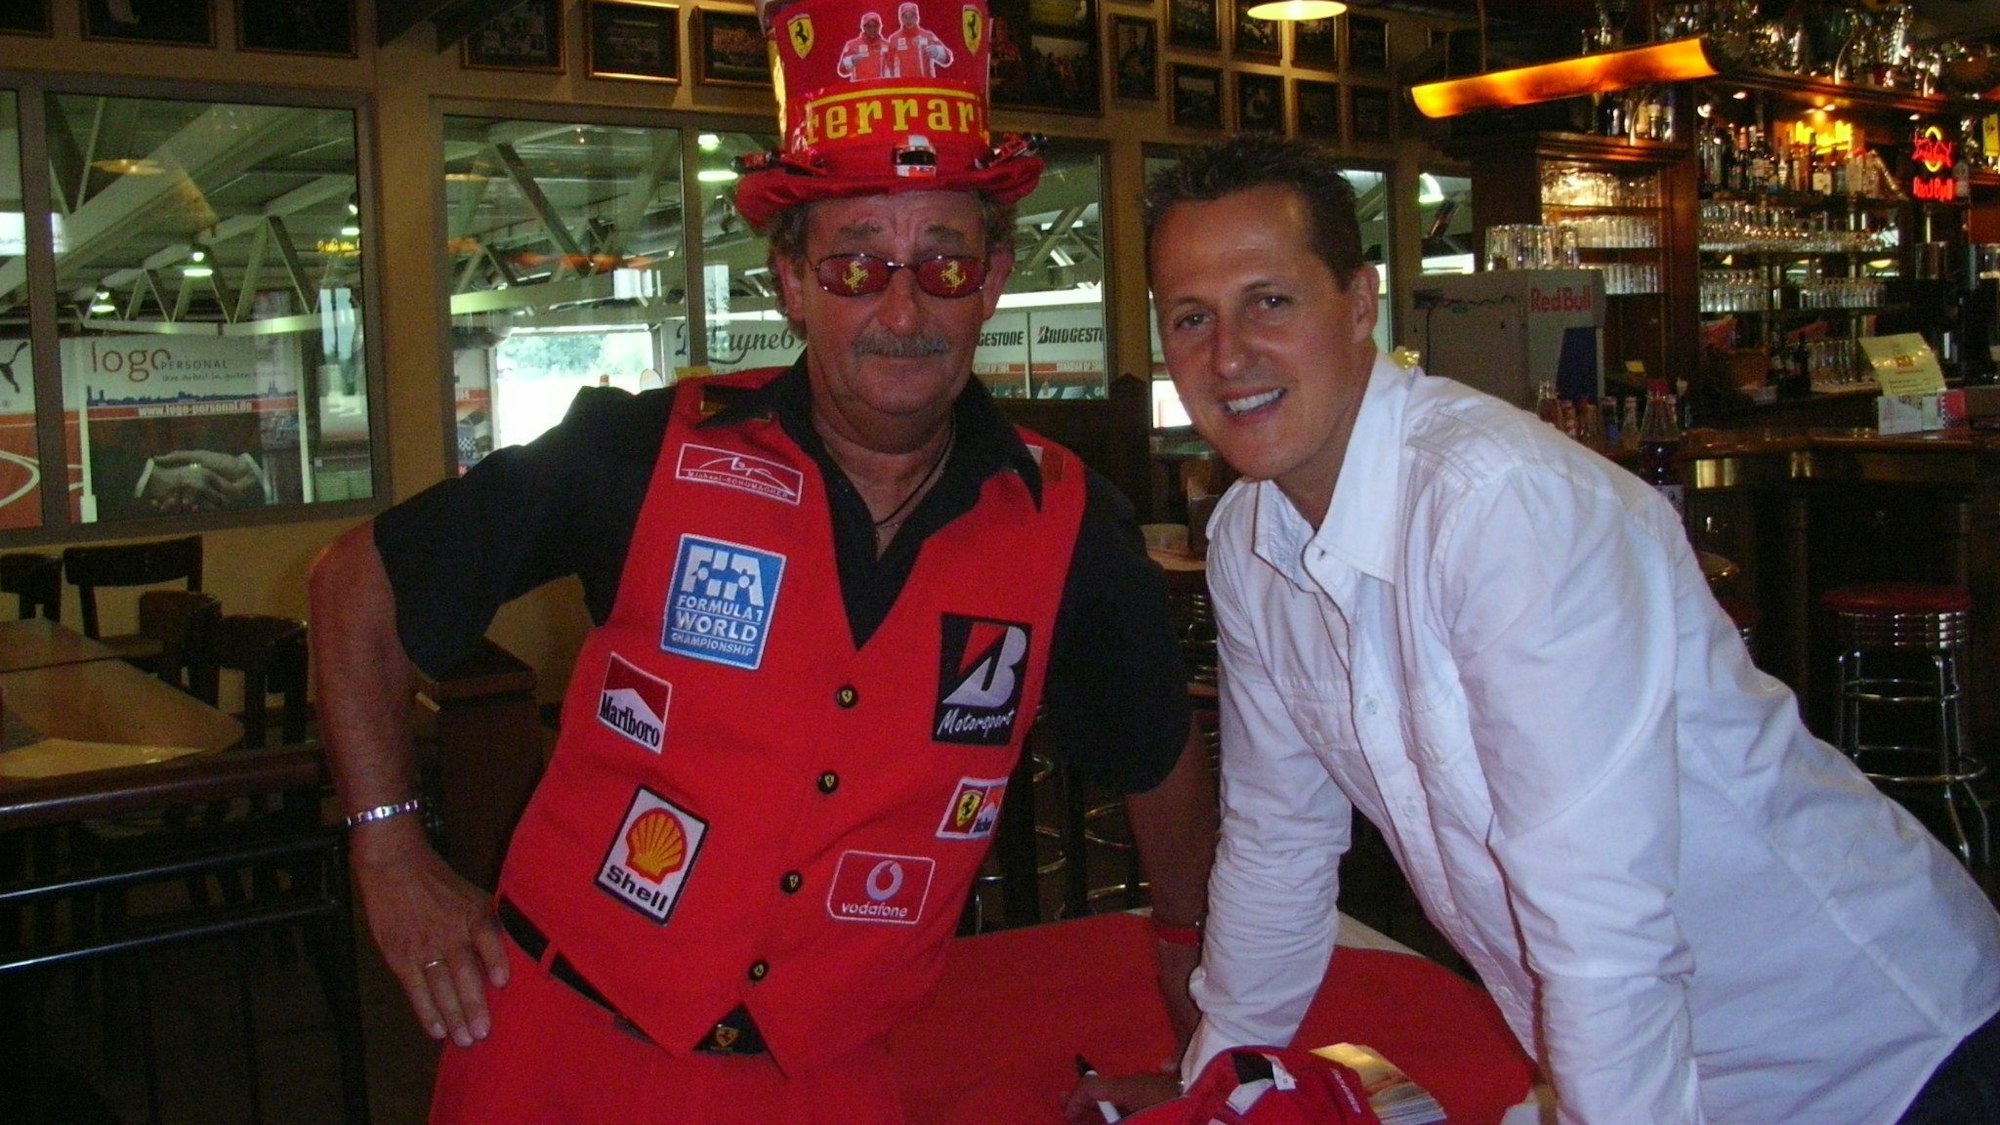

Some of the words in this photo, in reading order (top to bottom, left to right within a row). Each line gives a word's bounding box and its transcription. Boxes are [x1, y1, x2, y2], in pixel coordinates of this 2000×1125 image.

[1530, 286, 1561, 312] Red
[1562, 284, 1592, 313] Bull
[977, 331, 1025, 347] GESTONE
[91, 341, 171, 382] logo
[161, 359, 229, 370] PERSONAL
[681, 545, 765, 607] FIA
[677, 594, 753, 620] FORMULA
[756, 609, 764, 622] 1
[676, 610, 758, 642] WORLD
[671, 632, 754, 656] CHAMPIONSHIP
[600, 692, 660, 748] Marlboro
[936, 707, 1016, 738] Motorsport
[606, 864, 668, 911] Shell
[841, 901, 909, 918] vodafone
